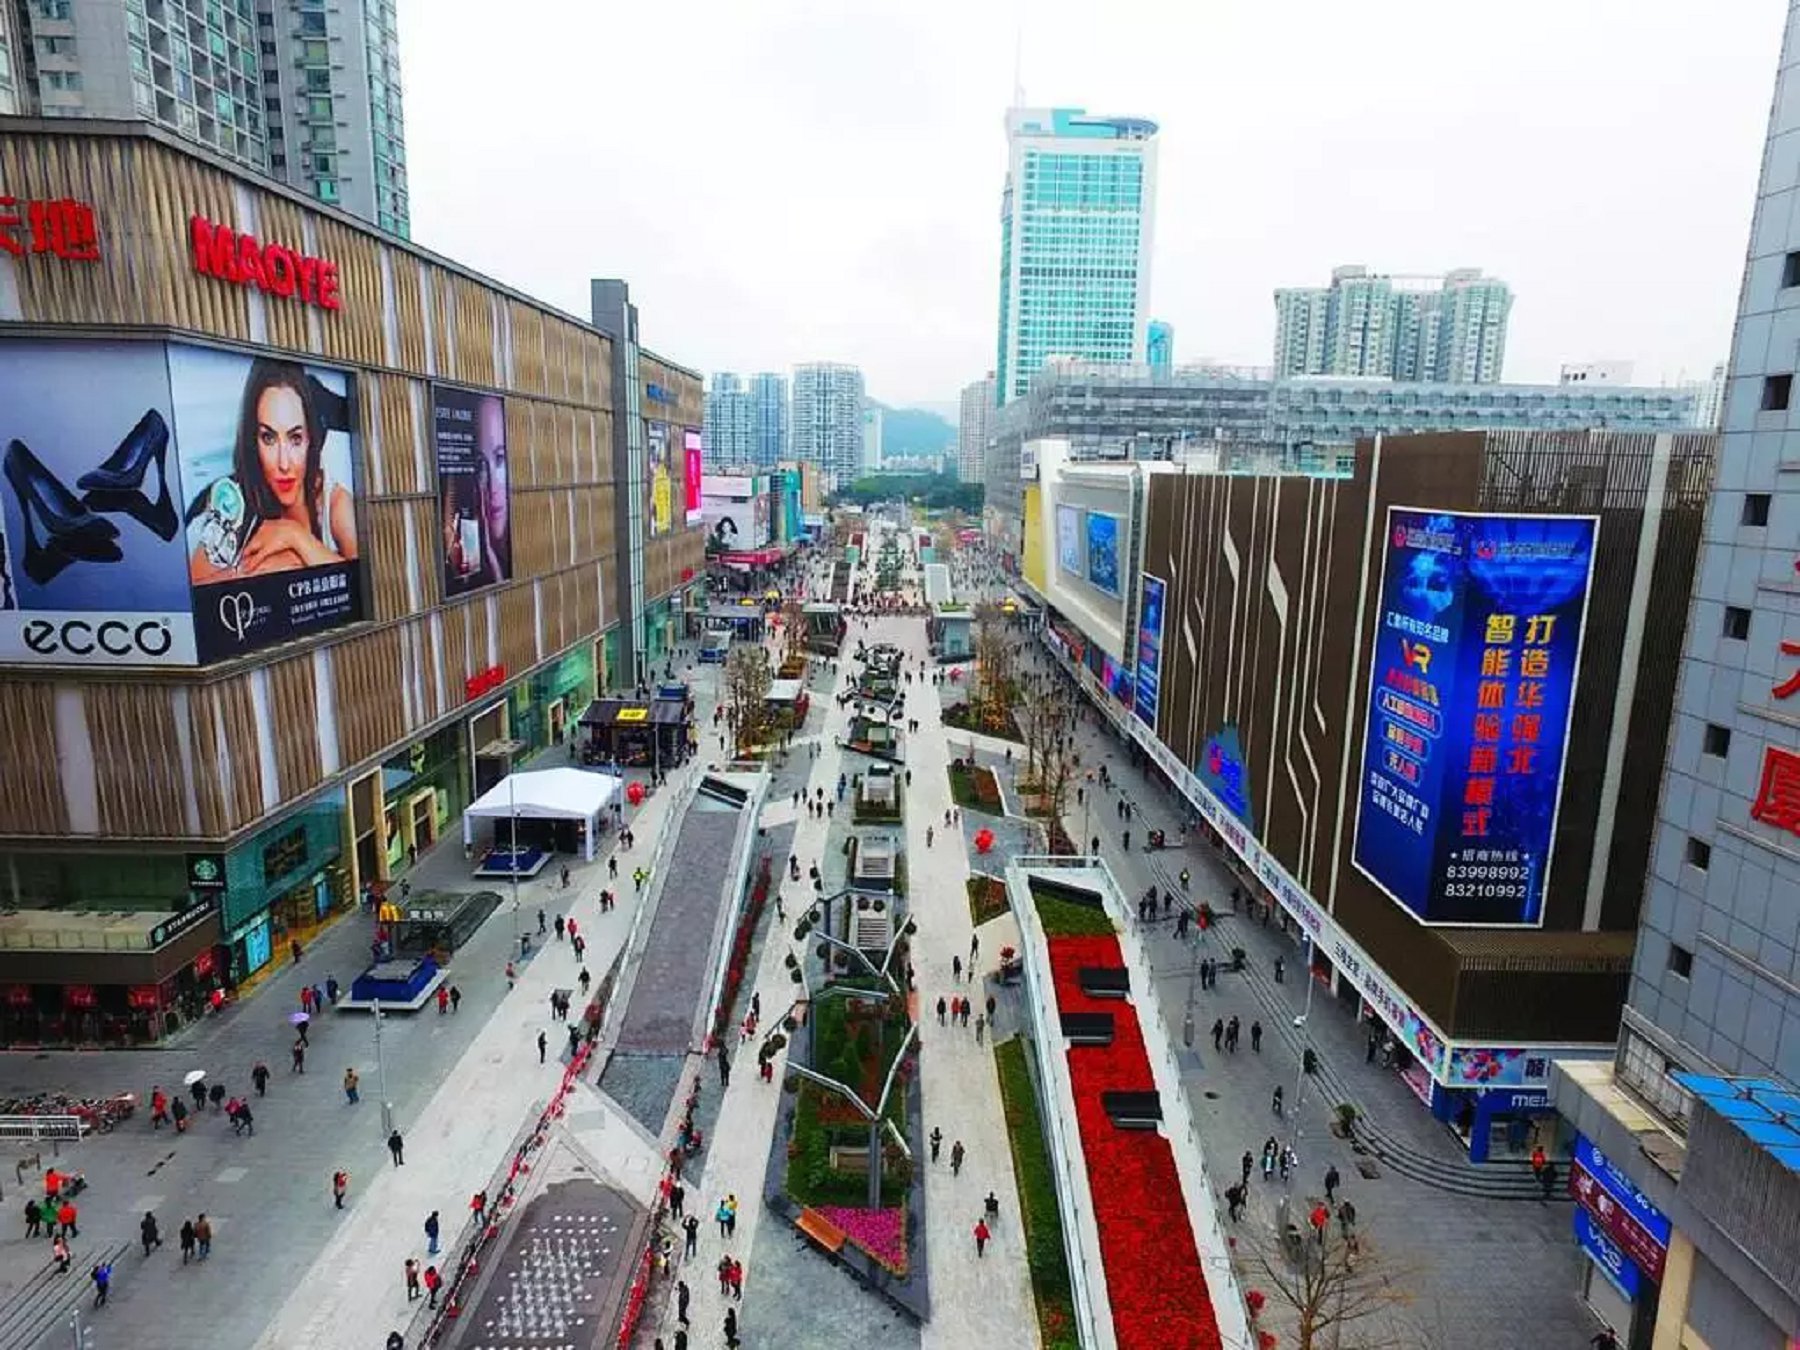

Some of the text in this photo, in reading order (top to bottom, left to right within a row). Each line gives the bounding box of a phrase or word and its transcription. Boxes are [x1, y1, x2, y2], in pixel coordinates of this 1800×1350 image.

[191, 212, 340, 311] MAOYE
[23, 620, 172, 657] ecco
[1401, 638, 1432, 674] VR
[1505, 614, 1557, 774] 打造华强北
[1462, 613, 1516, 837] 智能体验新模式
[1446, 865, 1530, 880] 83998992
[1462, 849, 1519, 862] 招商热线
[1445, 883, 1527, 898] 83210992
